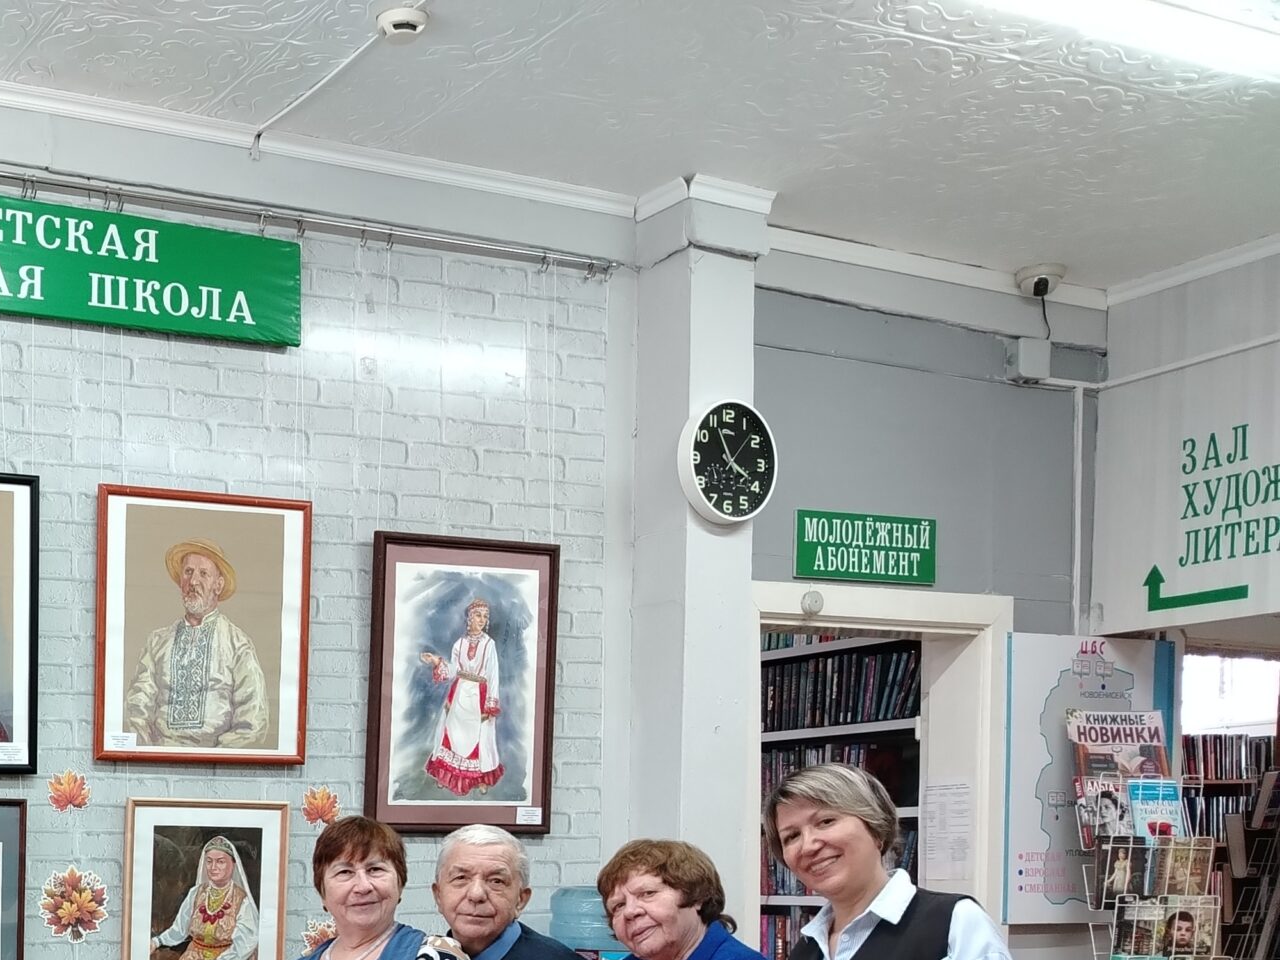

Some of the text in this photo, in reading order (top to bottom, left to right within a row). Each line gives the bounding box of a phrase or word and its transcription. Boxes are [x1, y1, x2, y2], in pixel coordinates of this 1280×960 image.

[88, 273, 256, 325] ШКОЛА
[710, 414, 717, 428] 11
[723, 409, 735, 423] 12
[697, 428, 709, 443] 10
[750, 435, 760, 448] 2
[1181, 424, 1249, 475] ЗАЛ
[692, 451, 700, 464] 9
[756, 459, 765, 472] 3
[696, 476, 705, 488] 8
[750, 481, 760, 493] 4
[709, 493, 718, 506] 7
[723, 500, 732, 513] 6
[739, 496, 748, 509] 5
[804, 517, 931, 550] МОЛОДЁЖНЫЙ
[1178, 516, 1280, 568] ЛИТЕР
[813, 546, 920, 577] АБОНЕМЕНТ
[1080, 640, 1106, 655] ЦБС
[1085, 713, 1147, 726] КНИЖНЫЕ
[1076, 725, 1162, 744] НОВИНКИ
